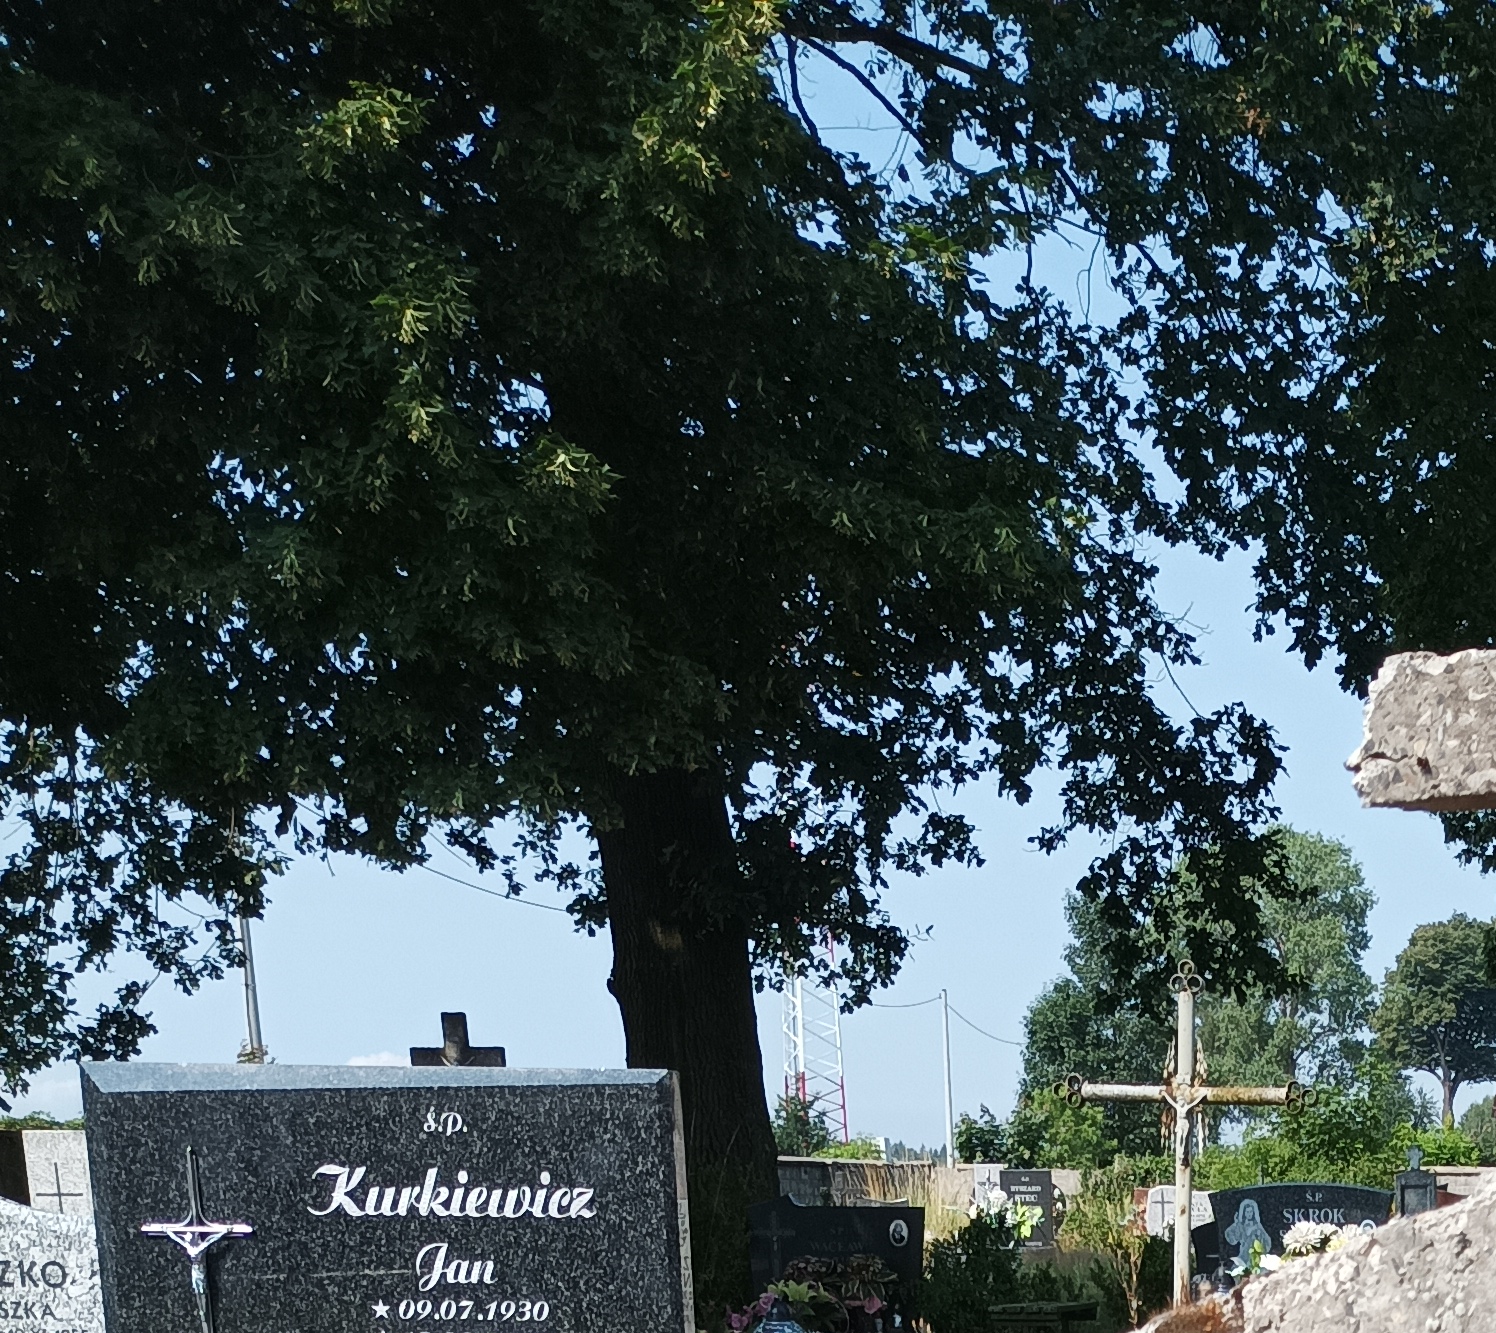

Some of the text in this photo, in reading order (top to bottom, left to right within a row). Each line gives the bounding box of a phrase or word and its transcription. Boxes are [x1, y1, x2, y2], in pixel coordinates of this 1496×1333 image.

[307, 1164, 598, 1219] Kurkiewicz
[1283, 1208, 1345, 1223] SKROK
[416, 1243, 496, 1292] Jan
[399, 1300, 549, 1321] 09.07.1930
